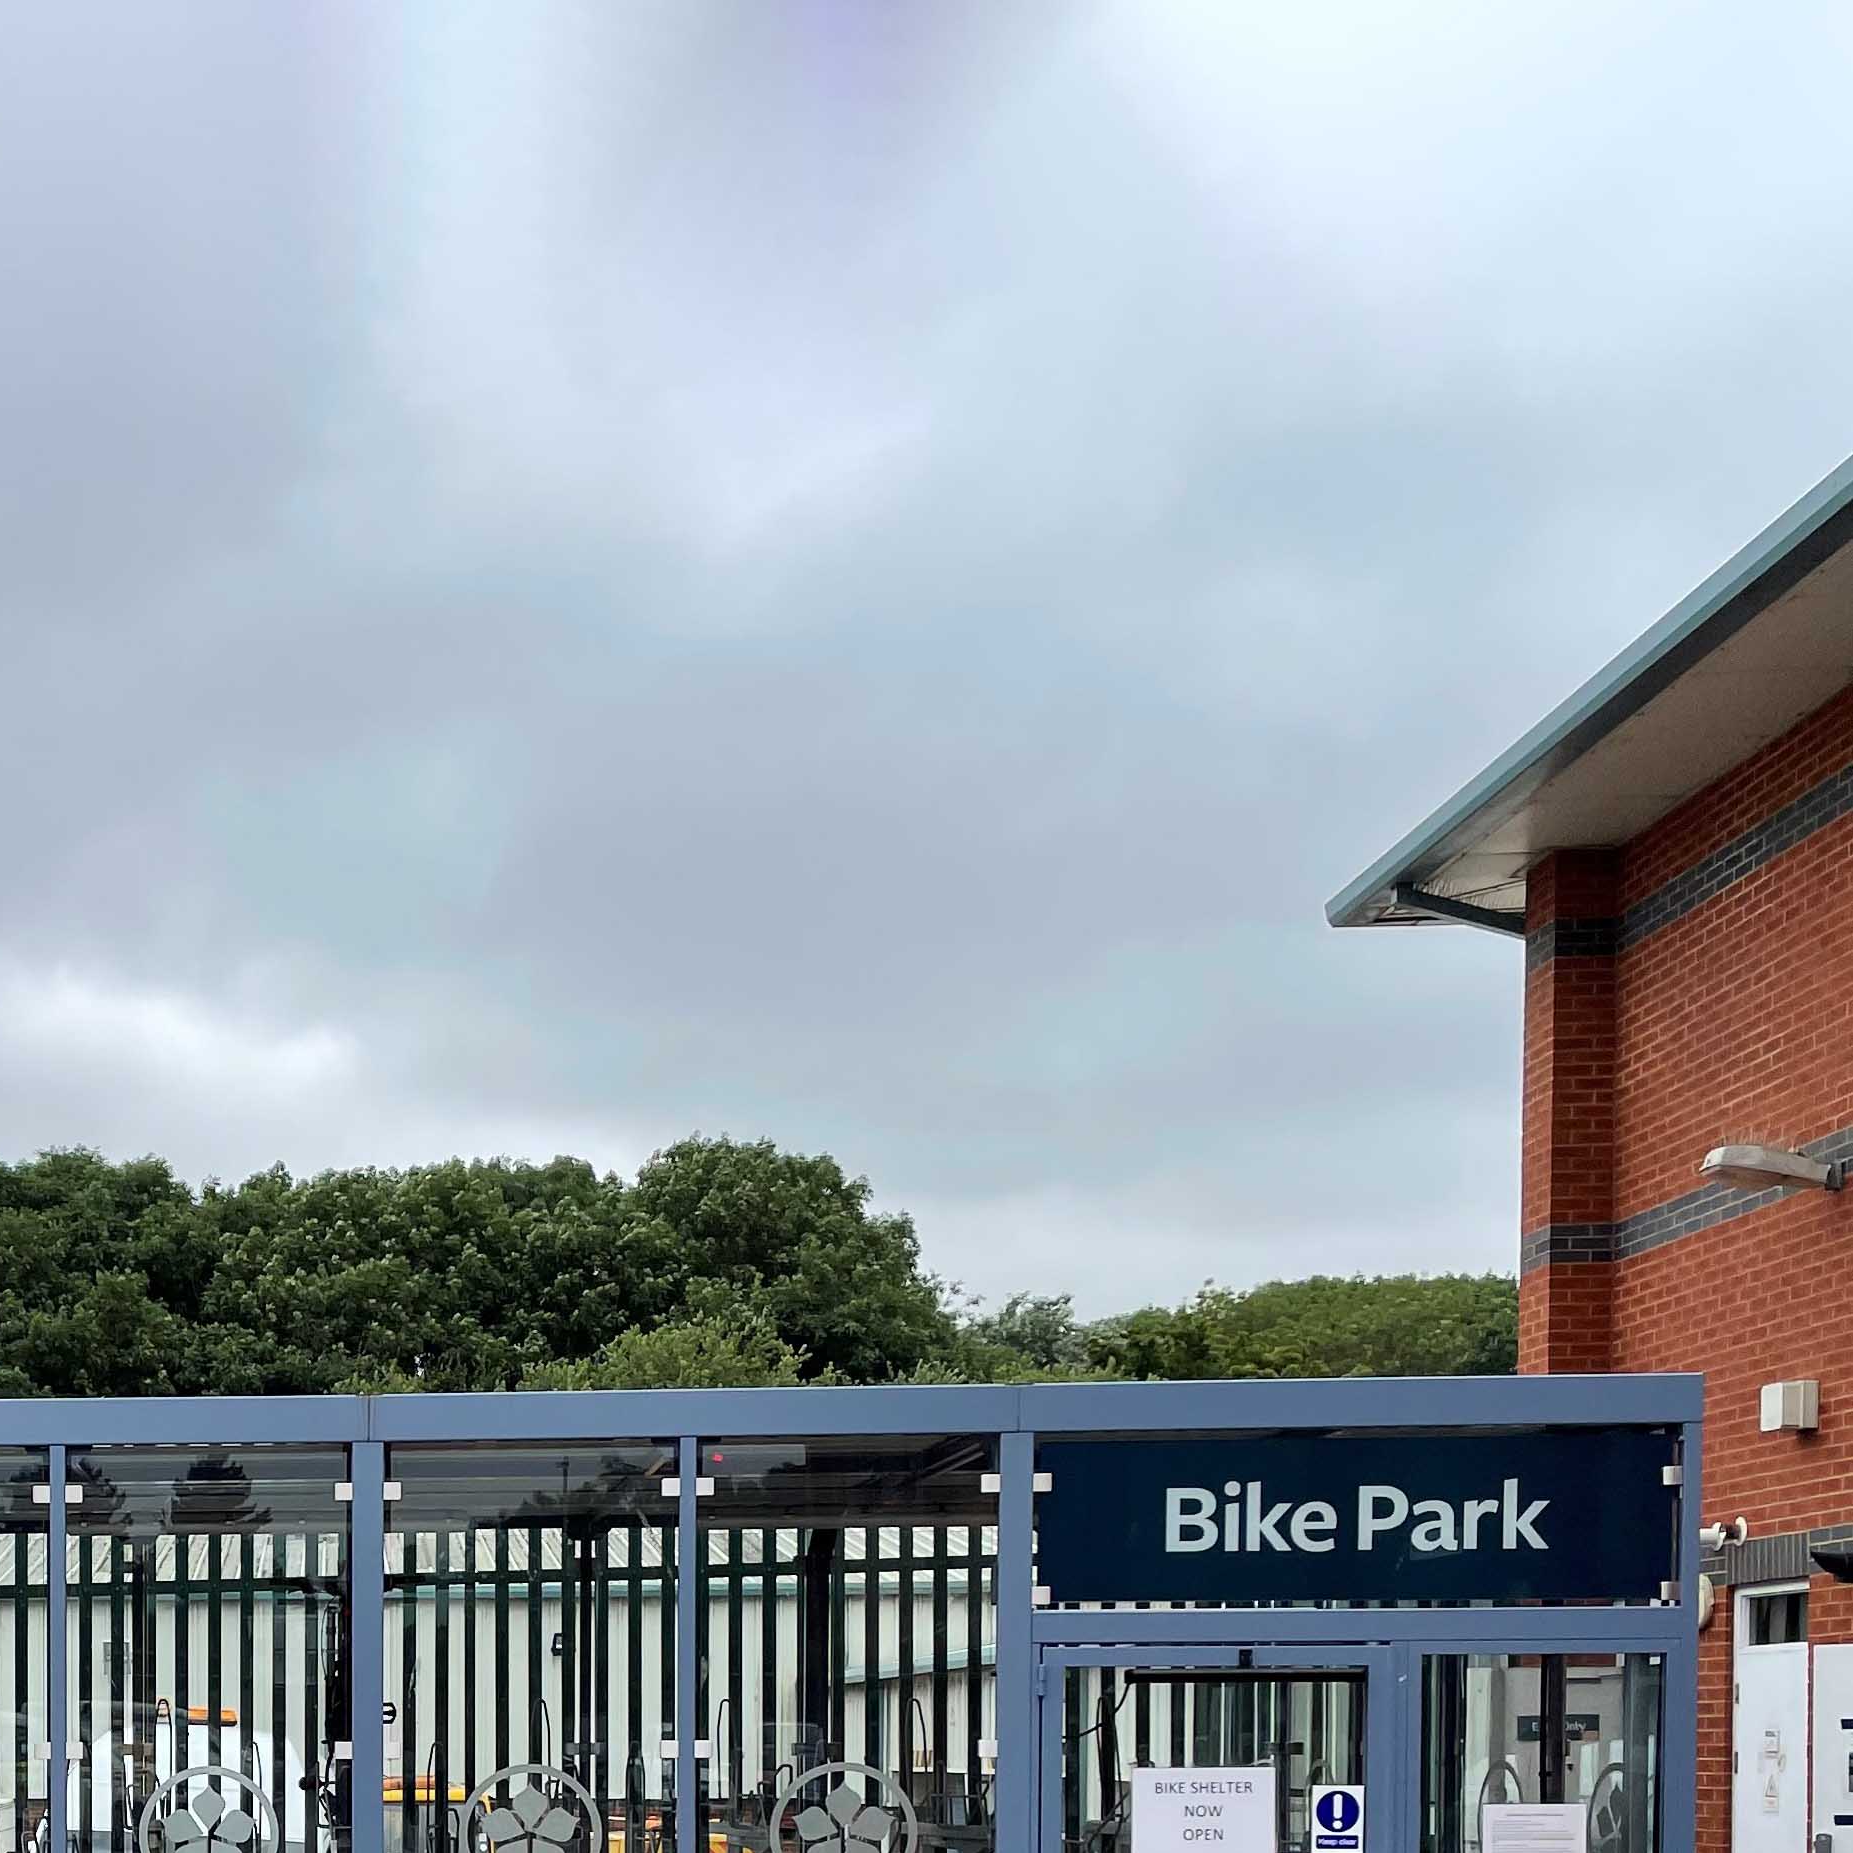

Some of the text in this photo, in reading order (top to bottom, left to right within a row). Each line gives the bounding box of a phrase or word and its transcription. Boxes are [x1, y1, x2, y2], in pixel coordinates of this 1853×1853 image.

[1165, 1478, 1550, 1552] Bike Park
[1154, 1781, 1253, 1794] BIKE SHELTER
[1184, 1805, 1224, 1817] NOW
[1183, 1828, 1224, 1841] OPEN
